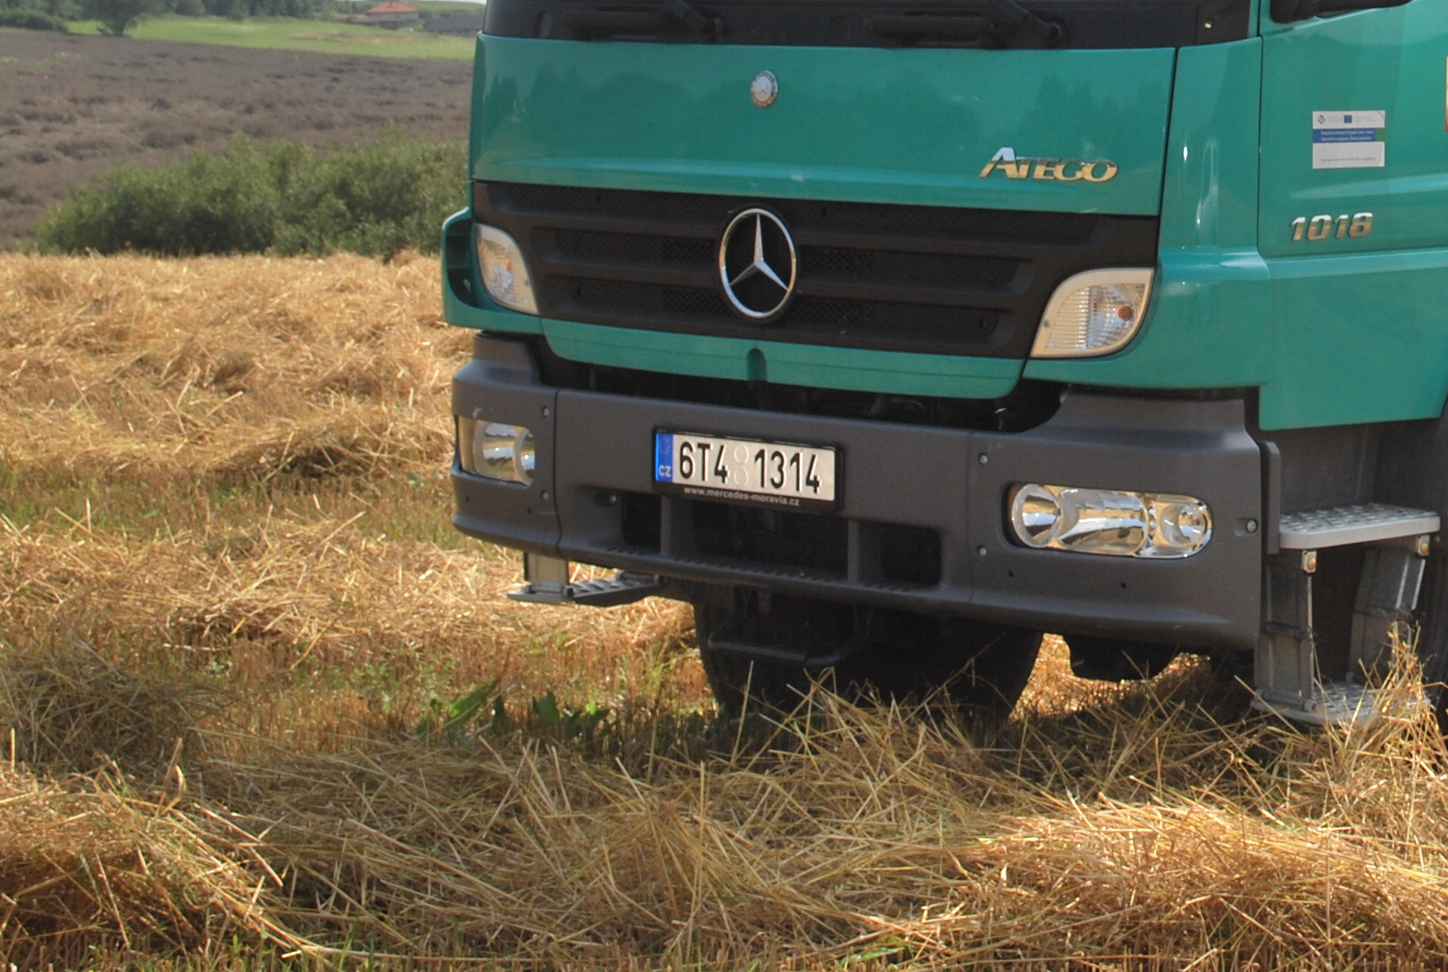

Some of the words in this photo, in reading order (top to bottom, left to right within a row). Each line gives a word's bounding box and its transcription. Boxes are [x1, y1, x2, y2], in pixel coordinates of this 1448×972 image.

[1290, 212, 1374, 242] 1018
[658, 464, 673, 478] CZ
[679, 441, 730, 485] 6T4
[754, 448, 821, 494] 1314
[684, 486, 801, 506] www.mercedes-moravia.cz
